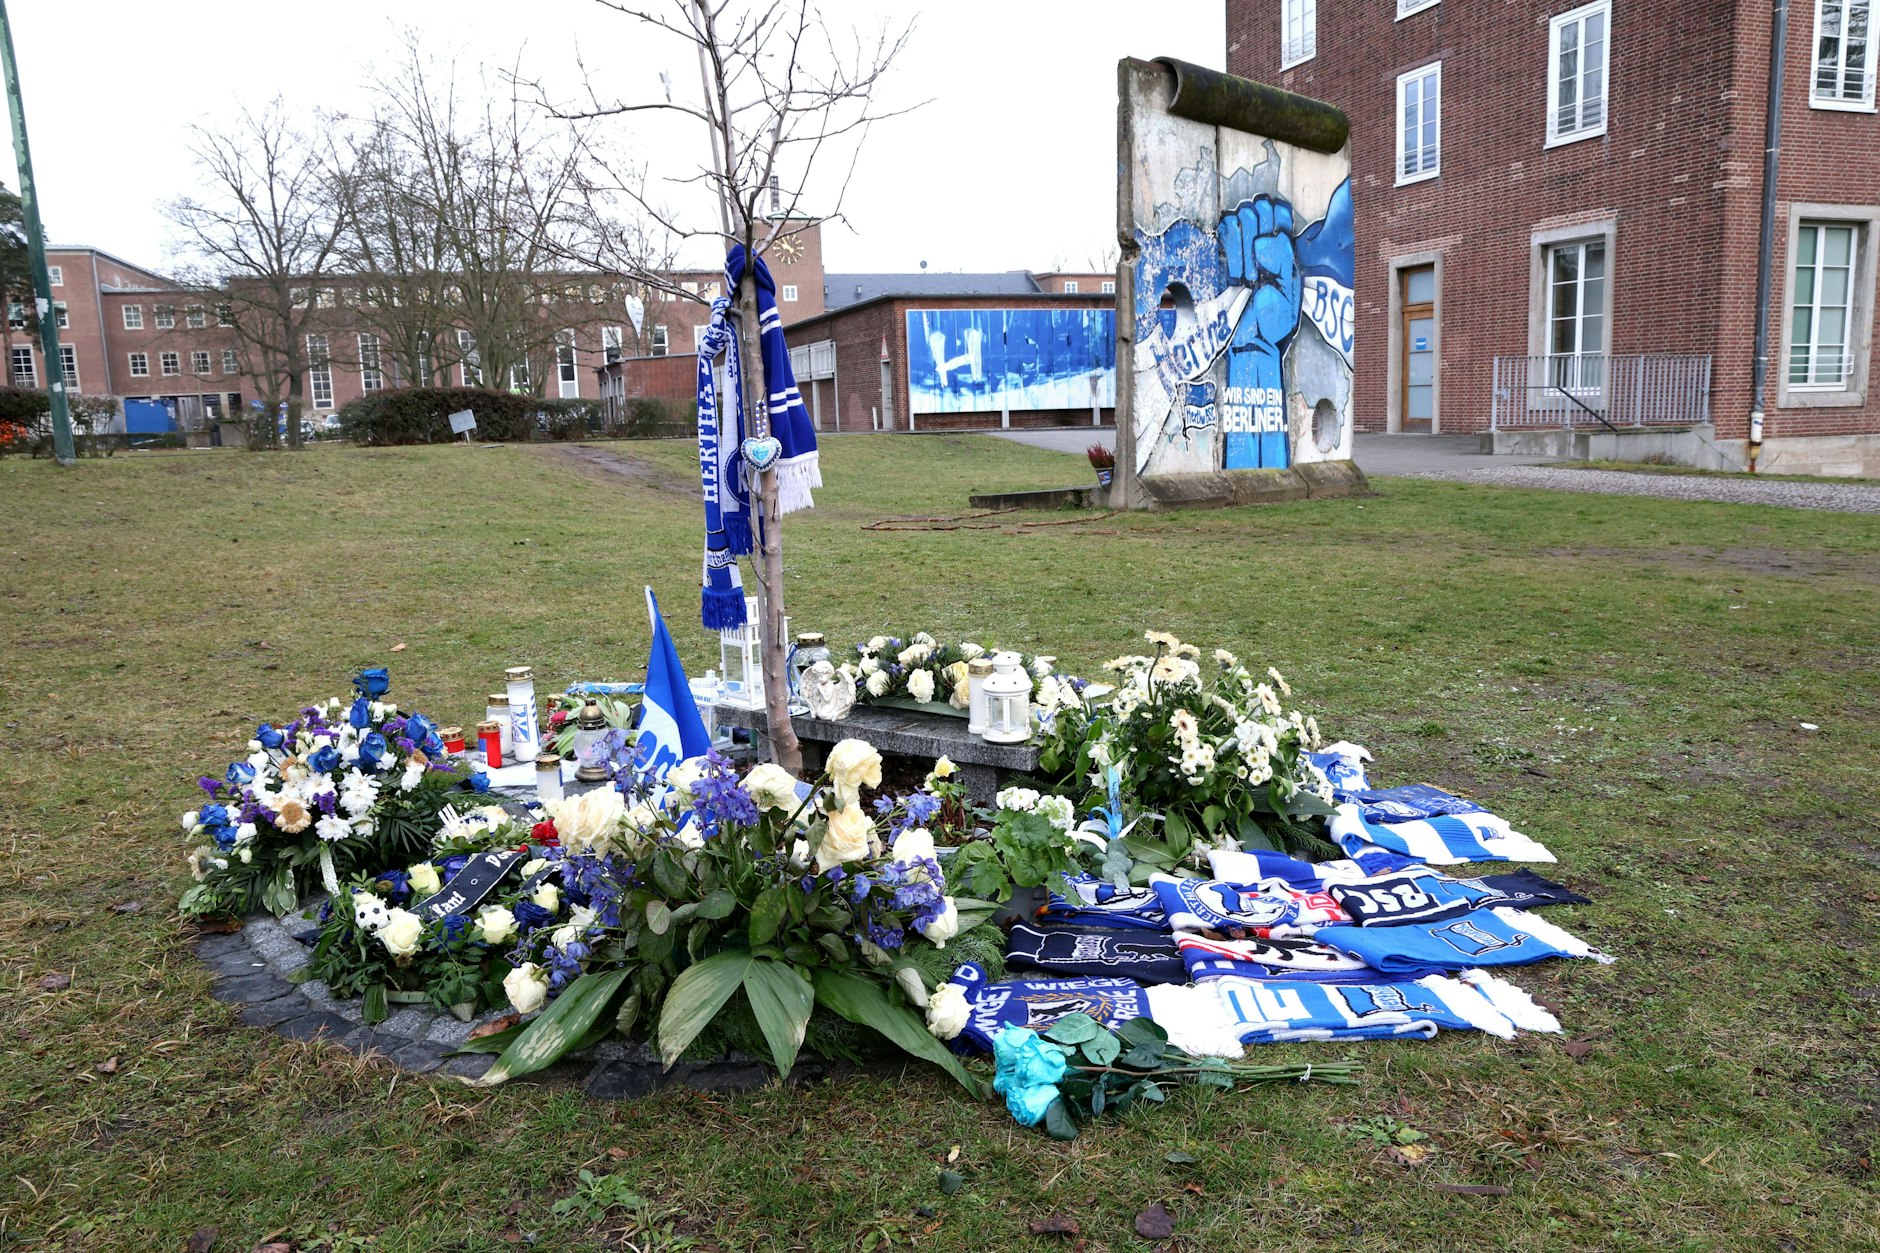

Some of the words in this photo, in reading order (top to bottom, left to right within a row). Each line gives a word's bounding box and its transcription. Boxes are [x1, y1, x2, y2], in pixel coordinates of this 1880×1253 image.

[1312, 280, 1353, 353] BSC
[1222, 387, 1243, 404] WIR
[1244, 388, 1266, 405] SIND
[1266, 388, 1283, 406] EIN
[1223, 405, 1288, 433] BERLINER.
[697, 383, 719, 504] HERTHA
[1345, 883, 1432, 914] BSC
[1024, 977, 1137, 991] WIEGE
